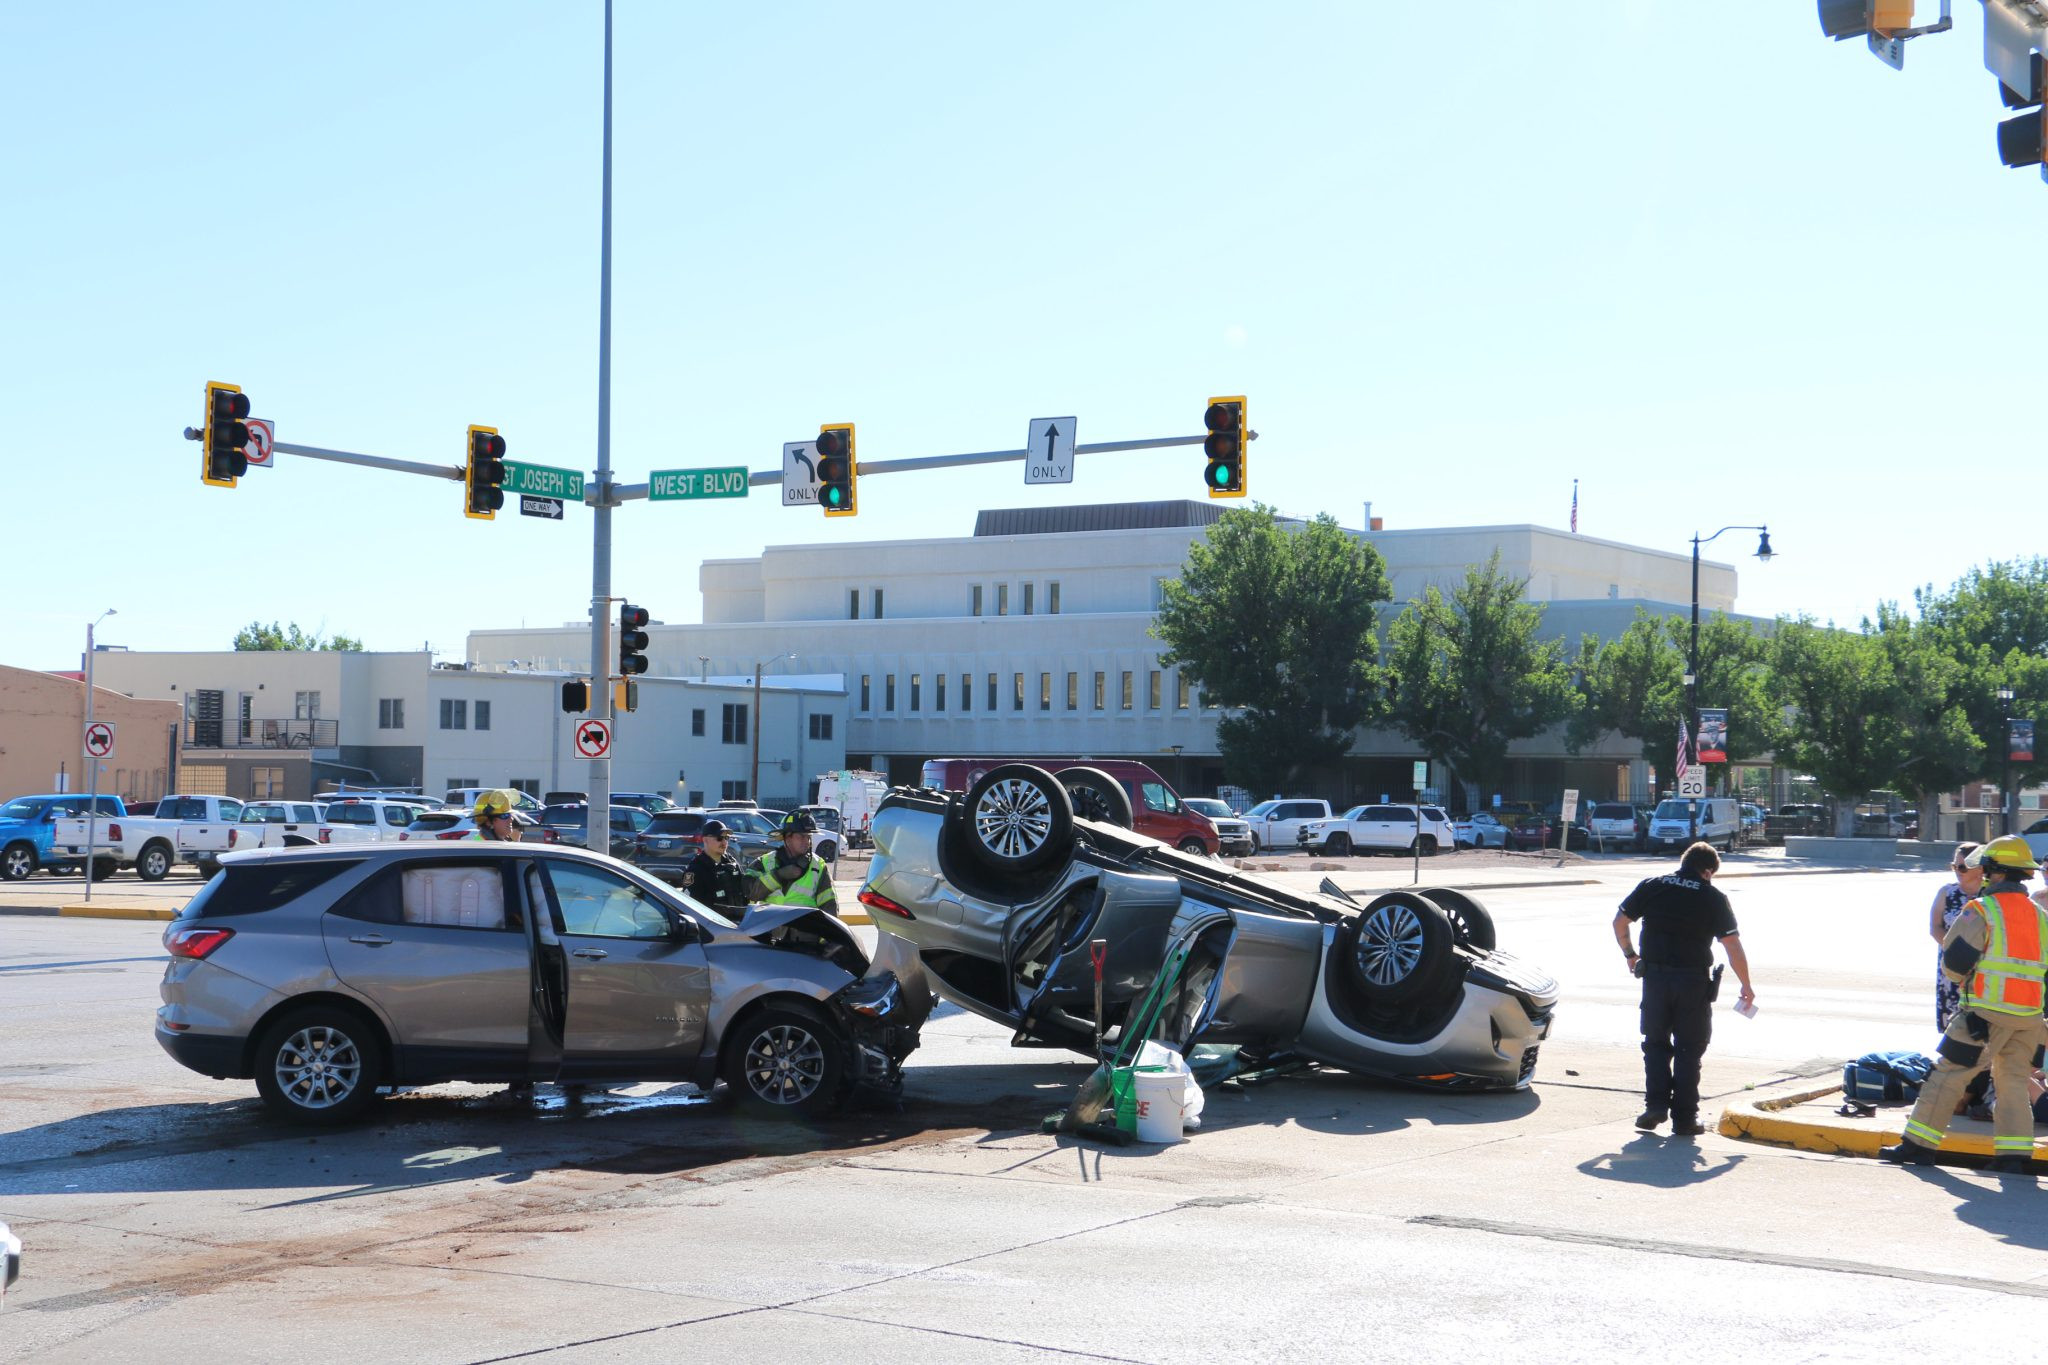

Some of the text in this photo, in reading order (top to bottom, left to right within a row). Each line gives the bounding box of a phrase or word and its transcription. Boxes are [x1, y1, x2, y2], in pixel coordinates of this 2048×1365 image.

[1032, 465, 1066, 478] ONLY
[520, 468, 564, 494] JOSEPH
[569, 475, 582, 496] ST
[653, 472, 744, 496] WEST BLVD
[788, 487, 819, 500] ONLY
[524, 501, 551, 512] ONE WAY
[1682, 782, 1702, 794] 20
[1662, 876, 1701, 890] POLICE
